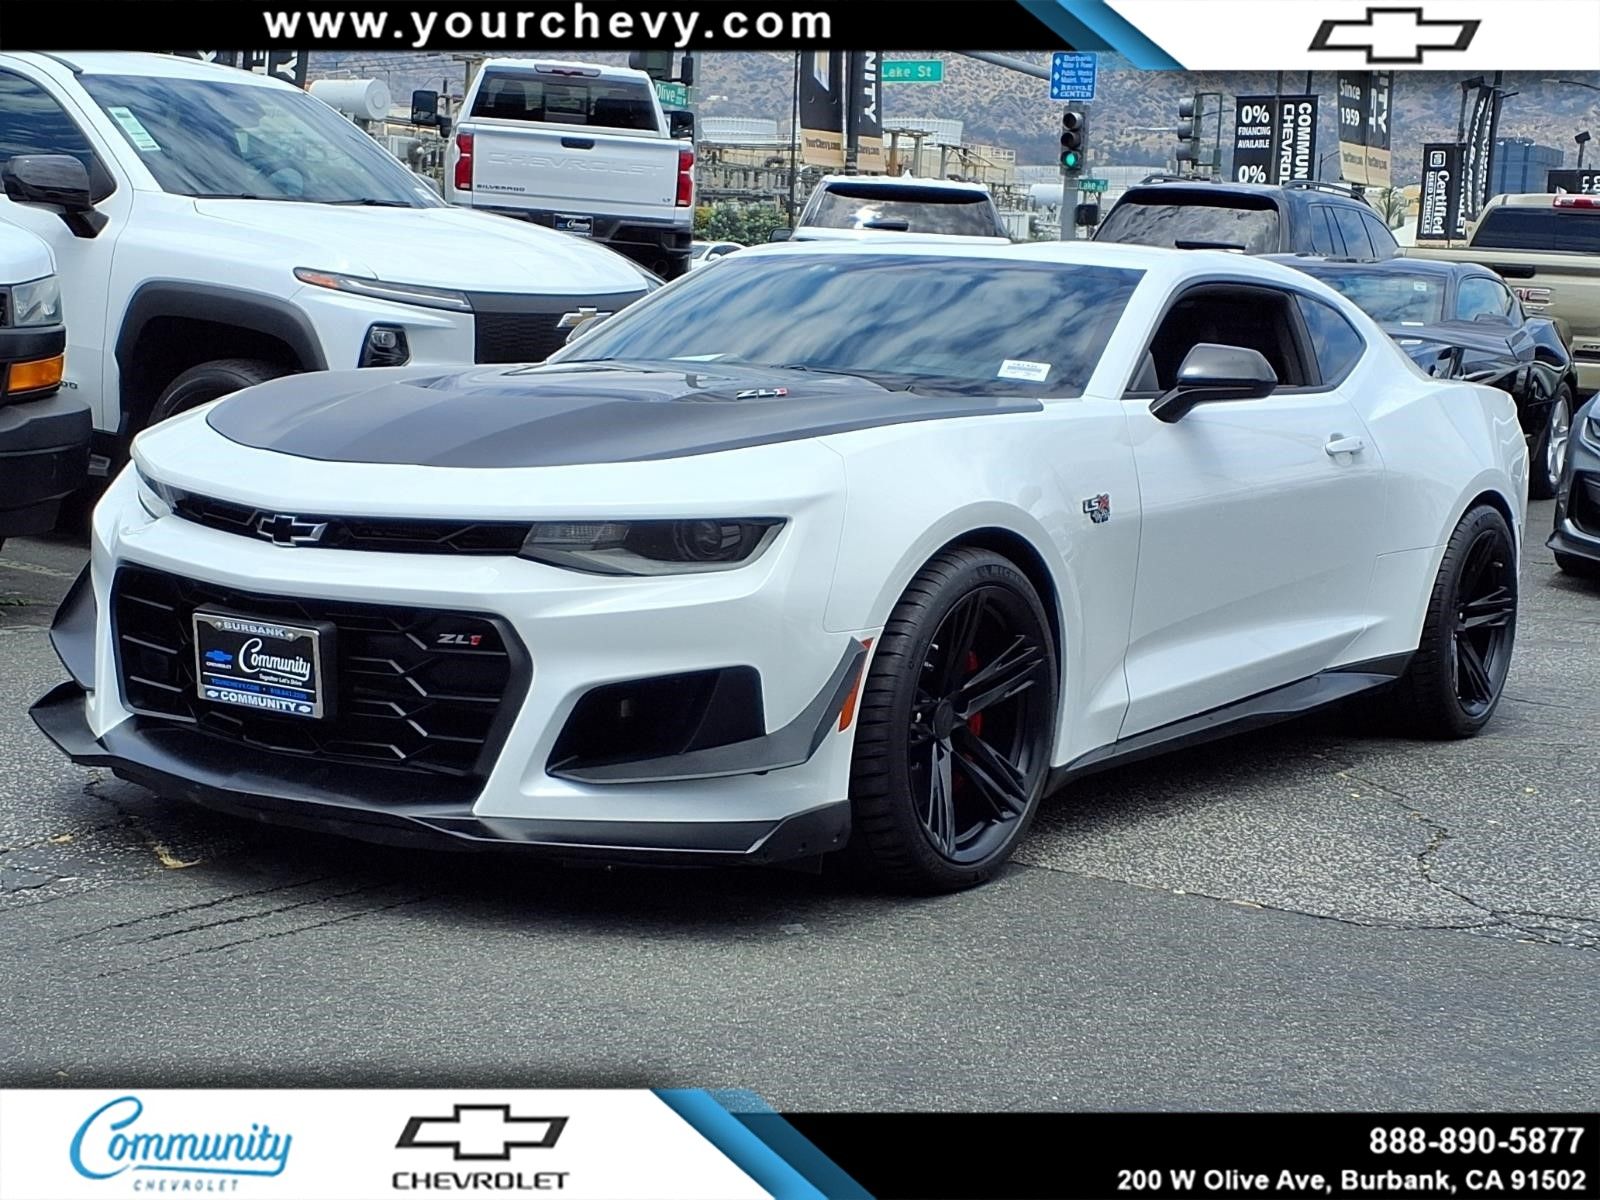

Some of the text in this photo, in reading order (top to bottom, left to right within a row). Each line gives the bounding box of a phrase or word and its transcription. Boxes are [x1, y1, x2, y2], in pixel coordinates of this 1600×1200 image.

[882, 65, 932, 78] Lake St
[655, 83, 676, 102] Olive
[1340, 78, 1361, 100] Since
[1241, 105, 1270, 124] 0%
[1340, 107, 1360, 127] 1959
[1238, 126, 1271, 136] FINANCING
[1237, 139, 1270, 149] AVAILABLE
[1238, 165, 1267, 183] 0%
[477, 184, 525, 192] SILVERADO
[1079, 181, 1096, 190] Lake
[1423, 171, 1435, 235] USED VEHICLES
[1432, 170, 1449, 235] Certified
[223, 621, 285, 637] BURBANK
[238, 638, 311, 681] Community
[220, 691, 297, 712] COMMUNITY
